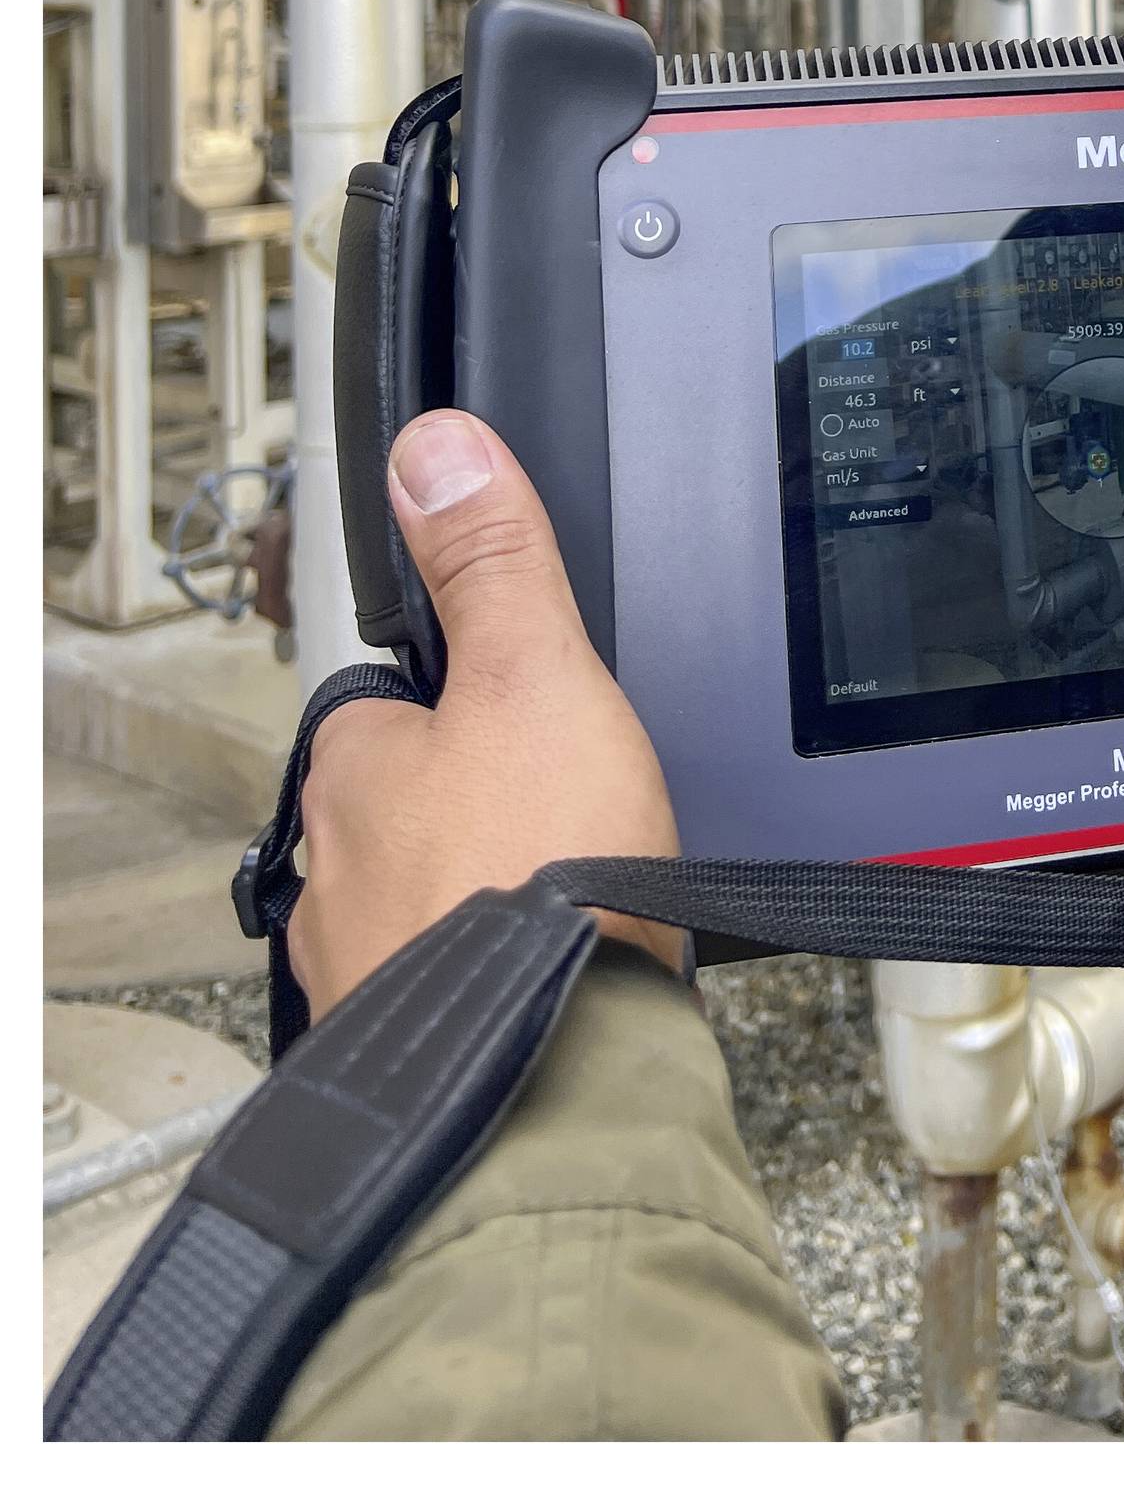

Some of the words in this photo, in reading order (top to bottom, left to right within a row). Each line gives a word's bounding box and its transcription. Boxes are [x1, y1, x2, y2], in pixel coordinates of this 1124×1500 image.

[843, 320, 899, 334] Pressure
[1068, 322, 1123, 339] 5909.39
[842, 342, 875, 357] 10.2
[911, 336, 931, 353] psi
[818, 374, 875, 388] Distance
[845, 393, 876, 408] 46.3
[913, 387, 926, 402] ft
[848, 417, 880, 430] Auto
[822, 450, 846, 462] Gas
[850, 446, 878, 459] Unit
[827, 468, 860, 486] ml/s
[849, 505, 909, 521] Advanced
[831, 680, 879, 696] Default
[1006, 788, 1075, 812] Megger
